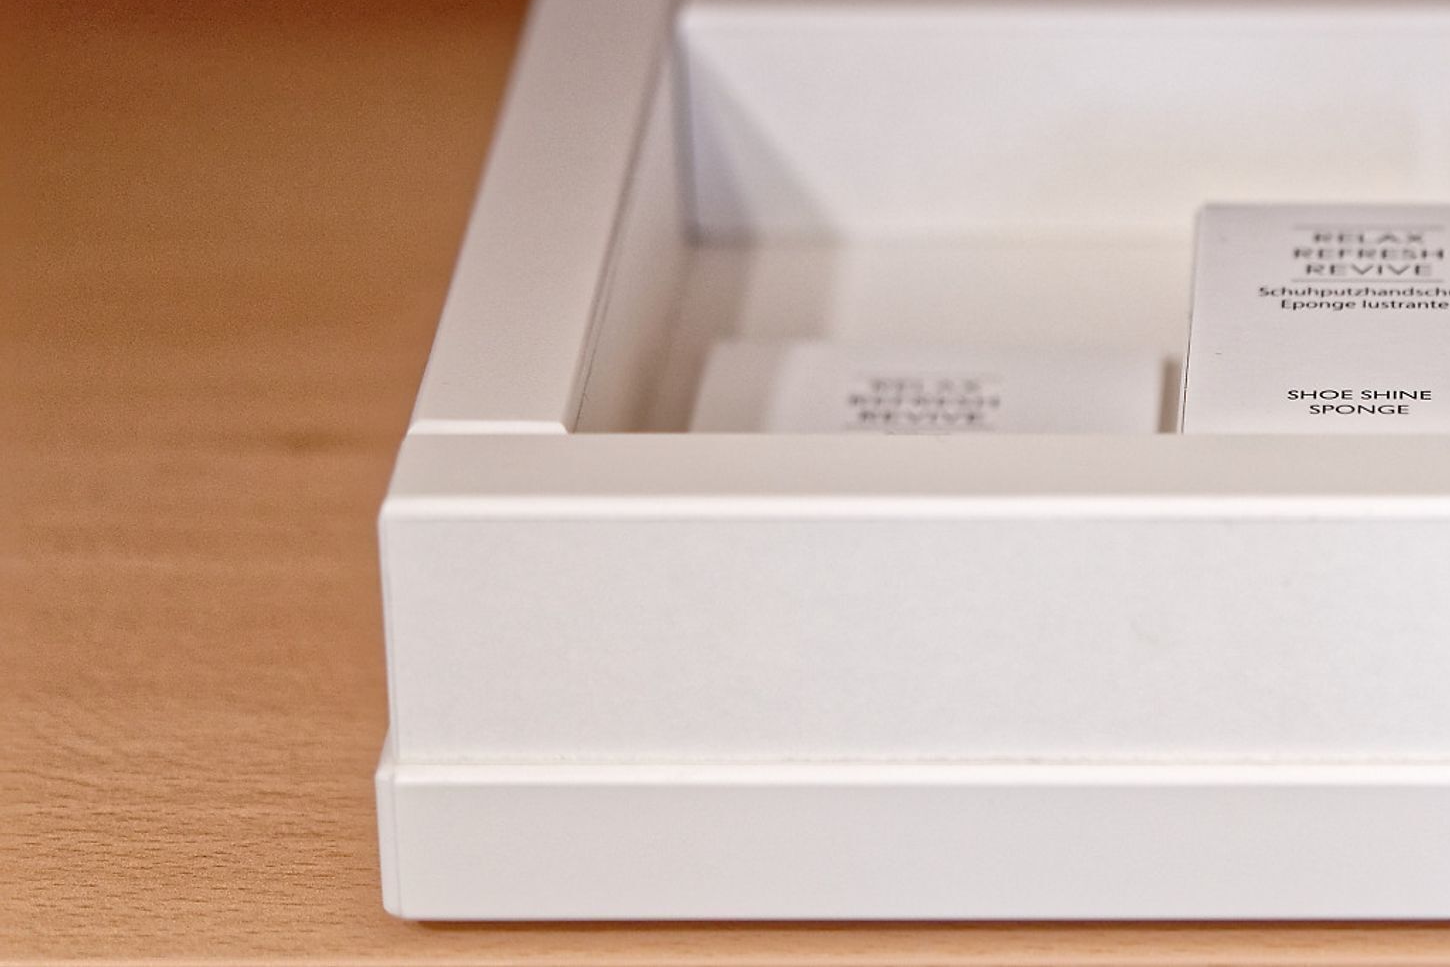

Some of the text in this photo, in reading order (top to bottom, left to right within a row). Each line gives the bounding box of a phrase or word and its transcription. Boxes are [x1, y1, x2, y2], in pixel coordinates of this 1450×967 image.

[1293, 248, 1445, 260] REFRESH
[1306, 263, 1432, 276] REVIVE
[1281, 299, 1450, 311] Eponge lustrante
[1287, 389, 1432, 401] SHOE SHINE
[1309, 404, 1410, 415] SPONGE
